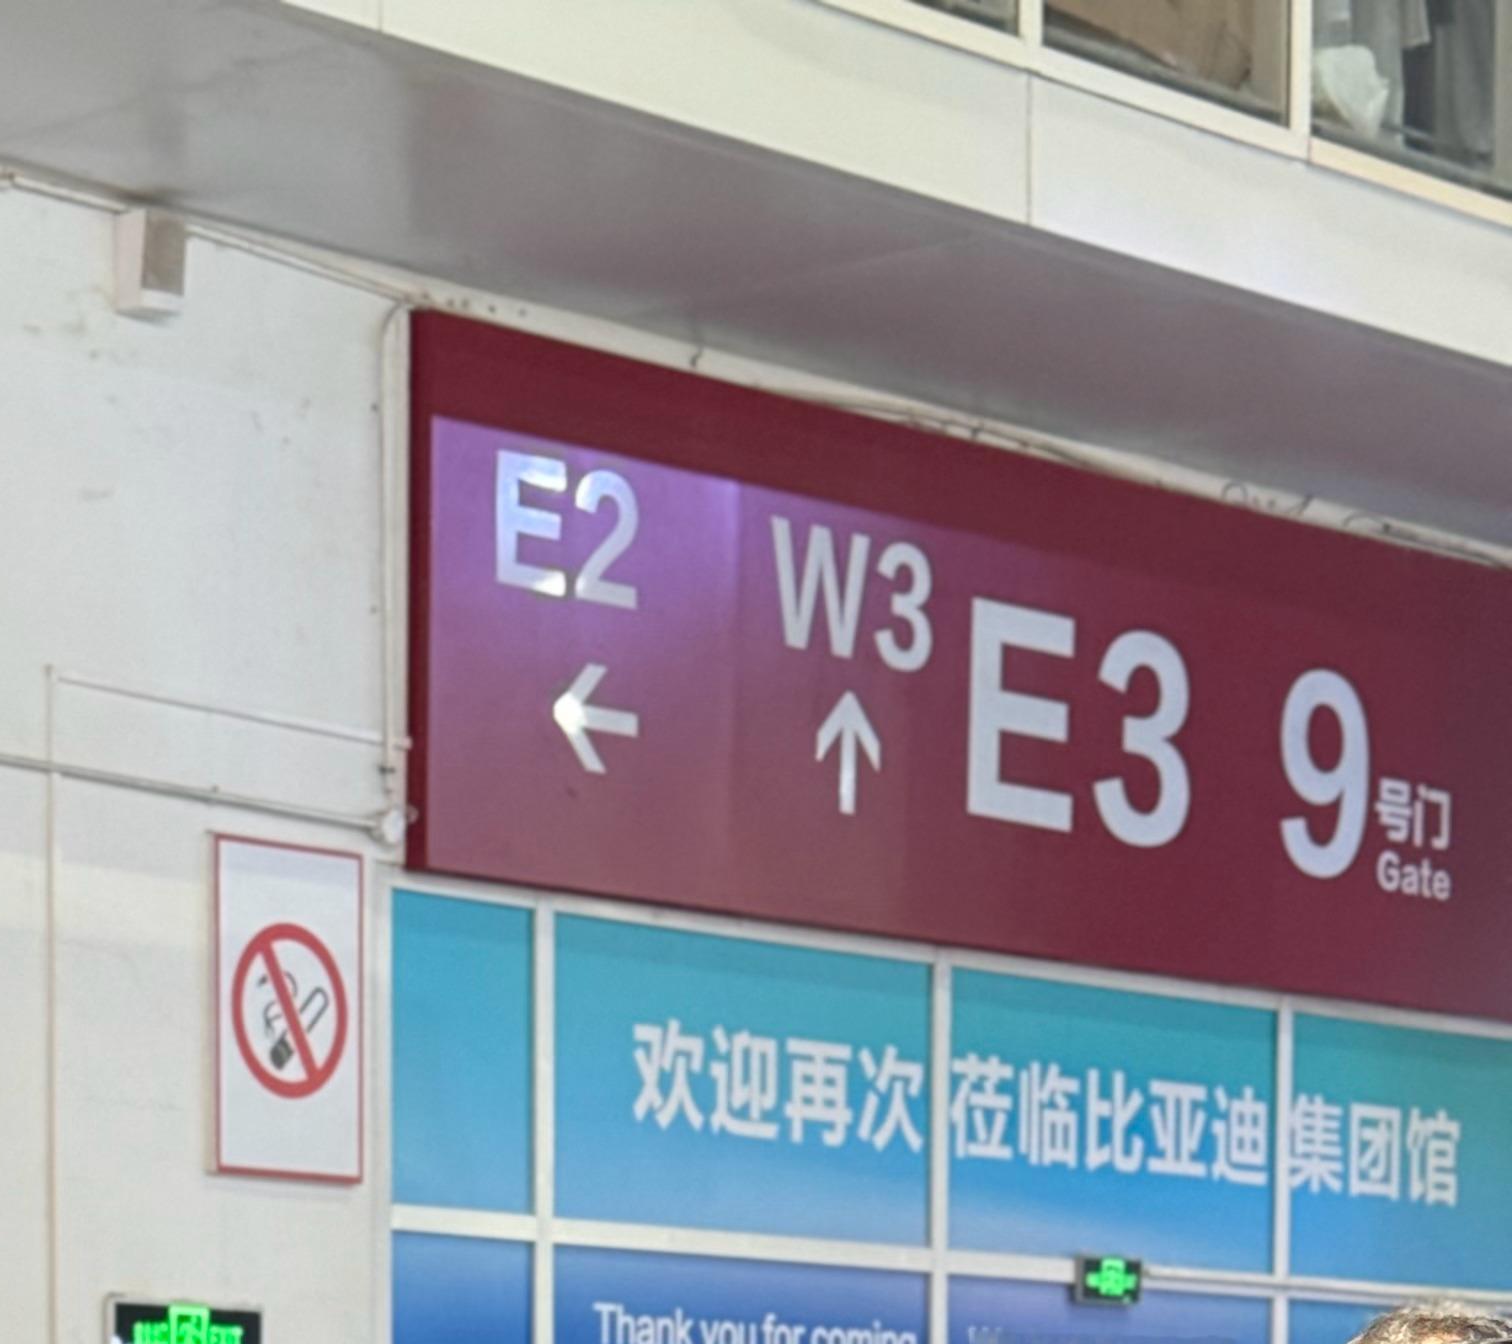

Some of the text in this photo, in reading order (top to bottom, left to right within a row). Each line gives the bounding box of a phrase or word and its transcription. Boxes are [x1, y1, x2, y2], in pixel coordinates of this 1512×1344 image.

[495, 449, 639, 610] E2
[771, 514, 933, 672] W3
[967, 596, 1370, 879] E3 9
[1374, 777, 1451, 851] 号门
[1375, 850, 1451, 901] Gate
